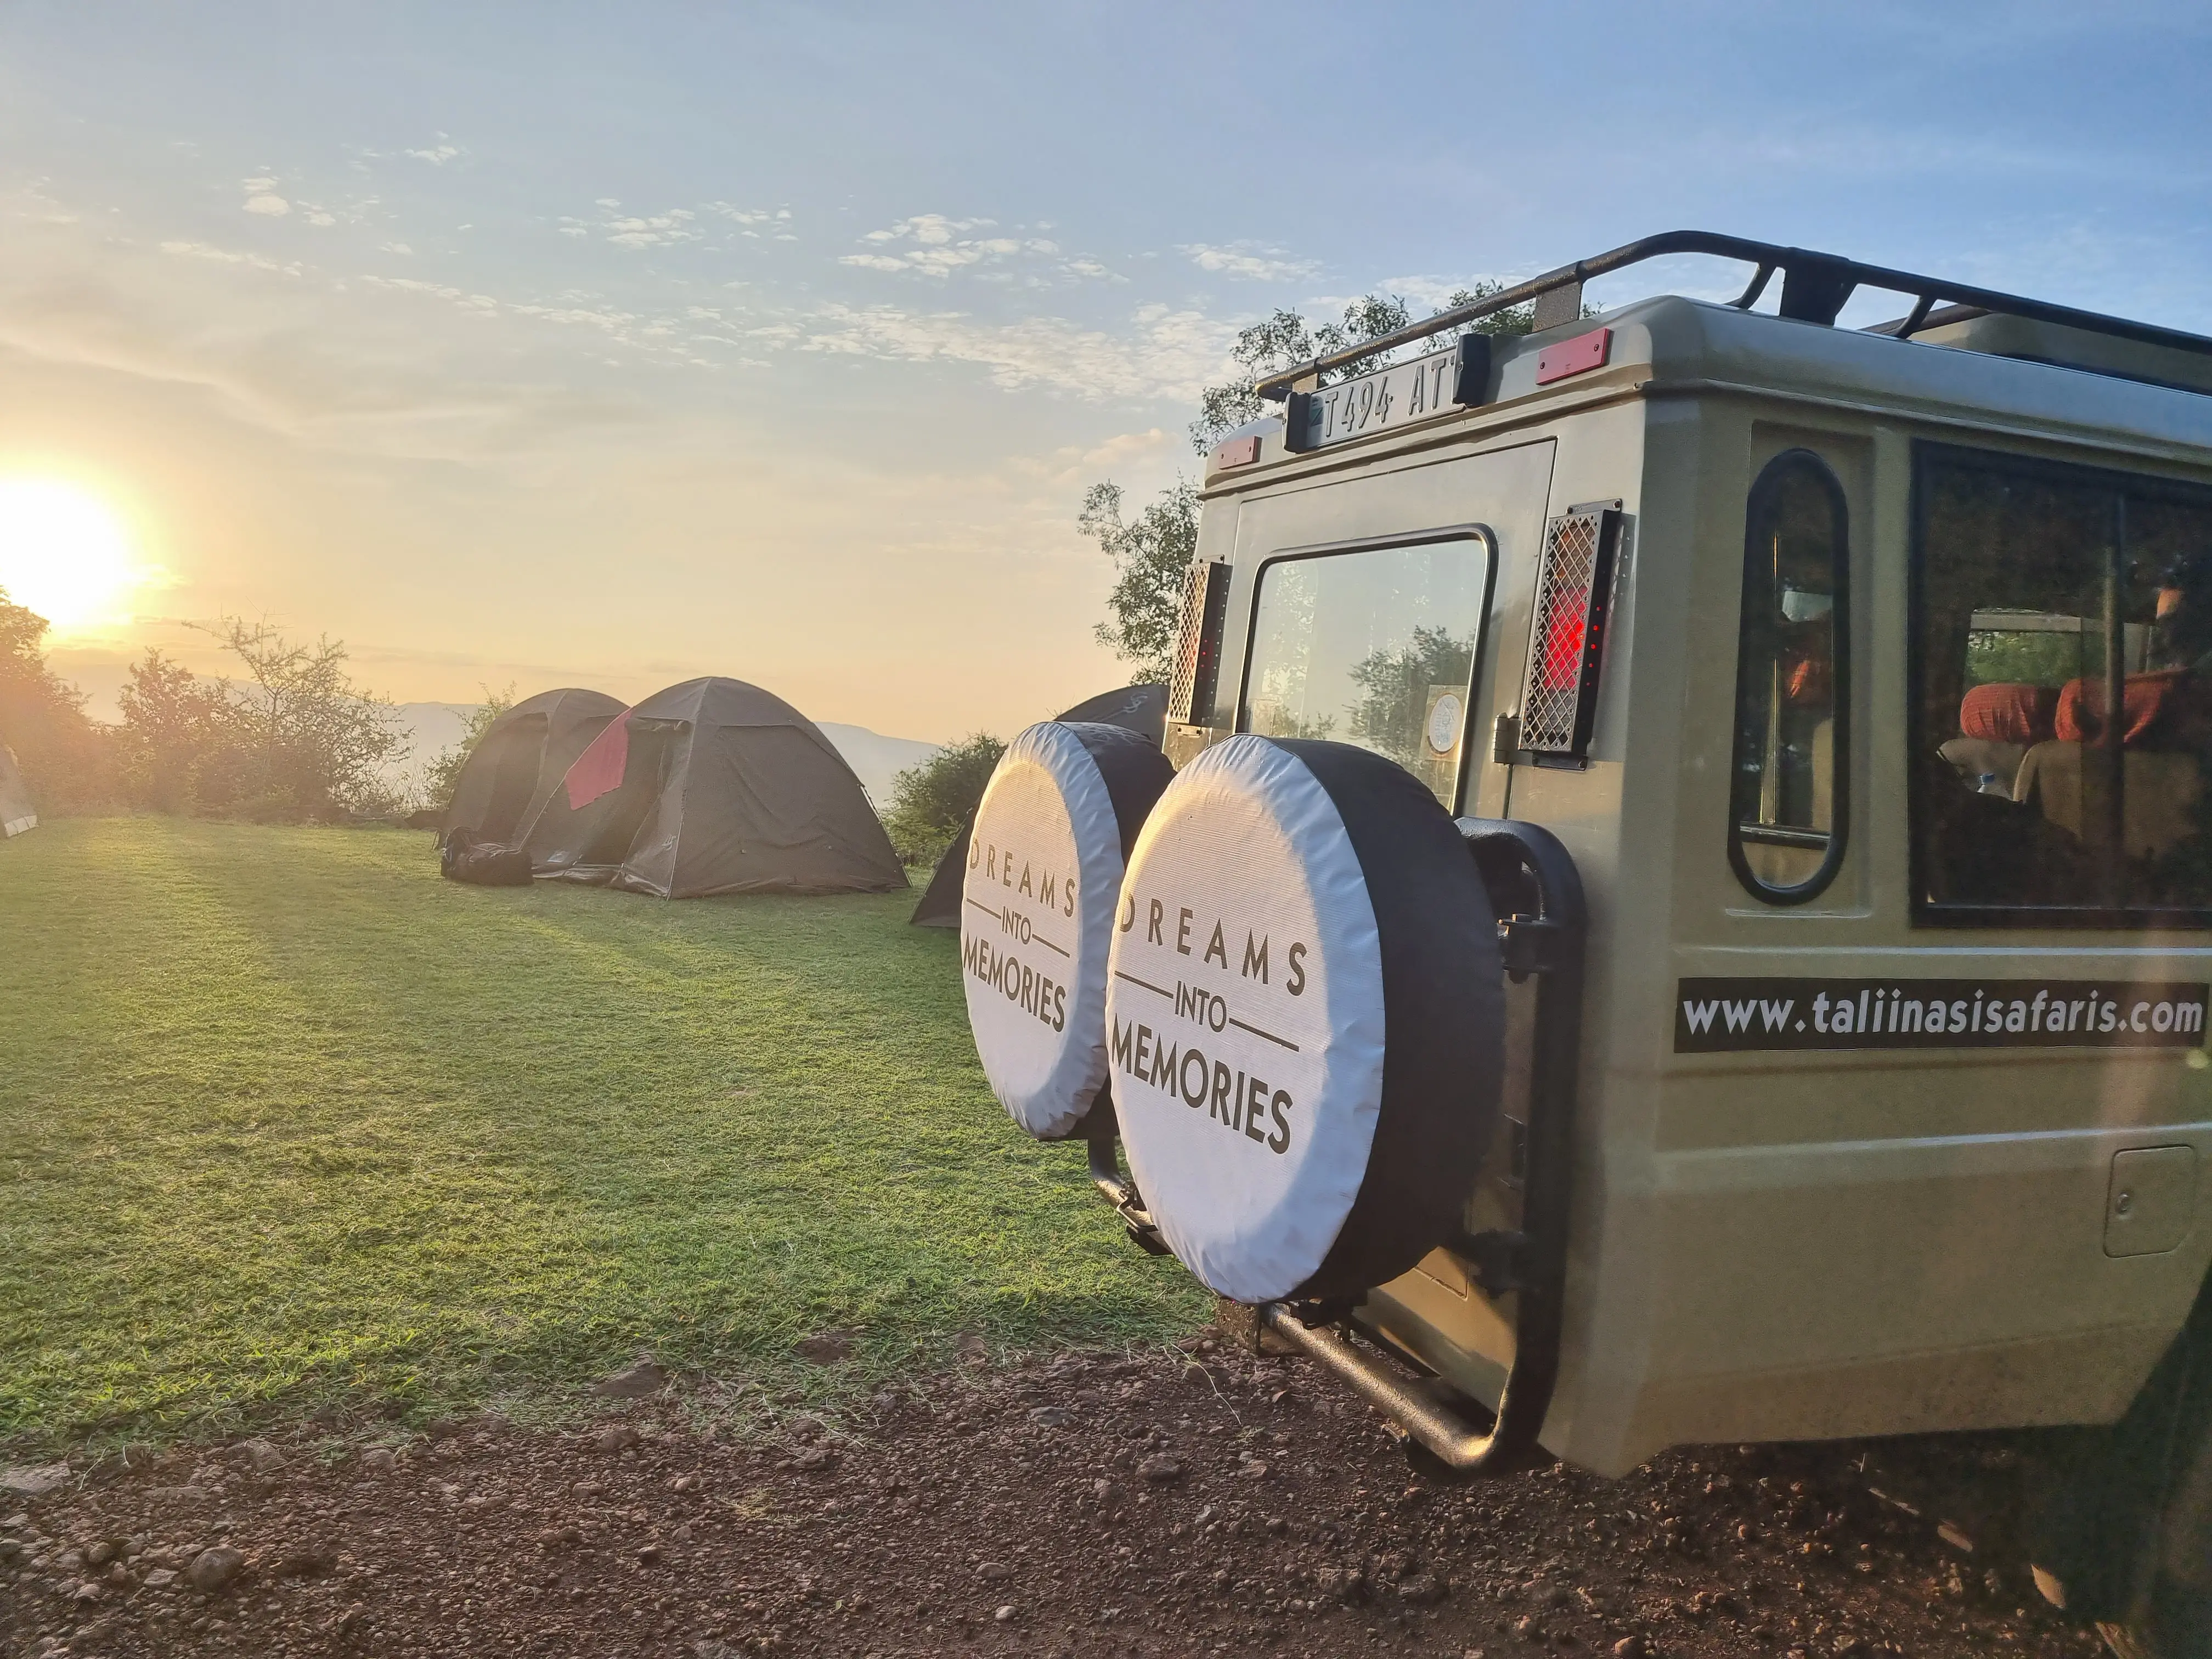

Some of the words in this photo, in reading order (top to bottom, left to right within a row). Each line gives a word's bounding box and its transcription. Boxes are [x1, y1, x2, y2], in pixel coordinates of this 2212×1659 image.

[1325, 376, 1389, 437] T494
[969, 838, 1076, 917] DREAMS
[1002, 906, 1031, 945] INTO
[1120, 893, 1307, 996] DREAMS
[963, 931, 1066, 1032] MEMORIES
[1175, 980, 1227, 1032] INTO
[1683, 988, 2203, 1035] www.taliinasisafaris.com
[1111, 1013, 1293, 1154] MEMORIES
